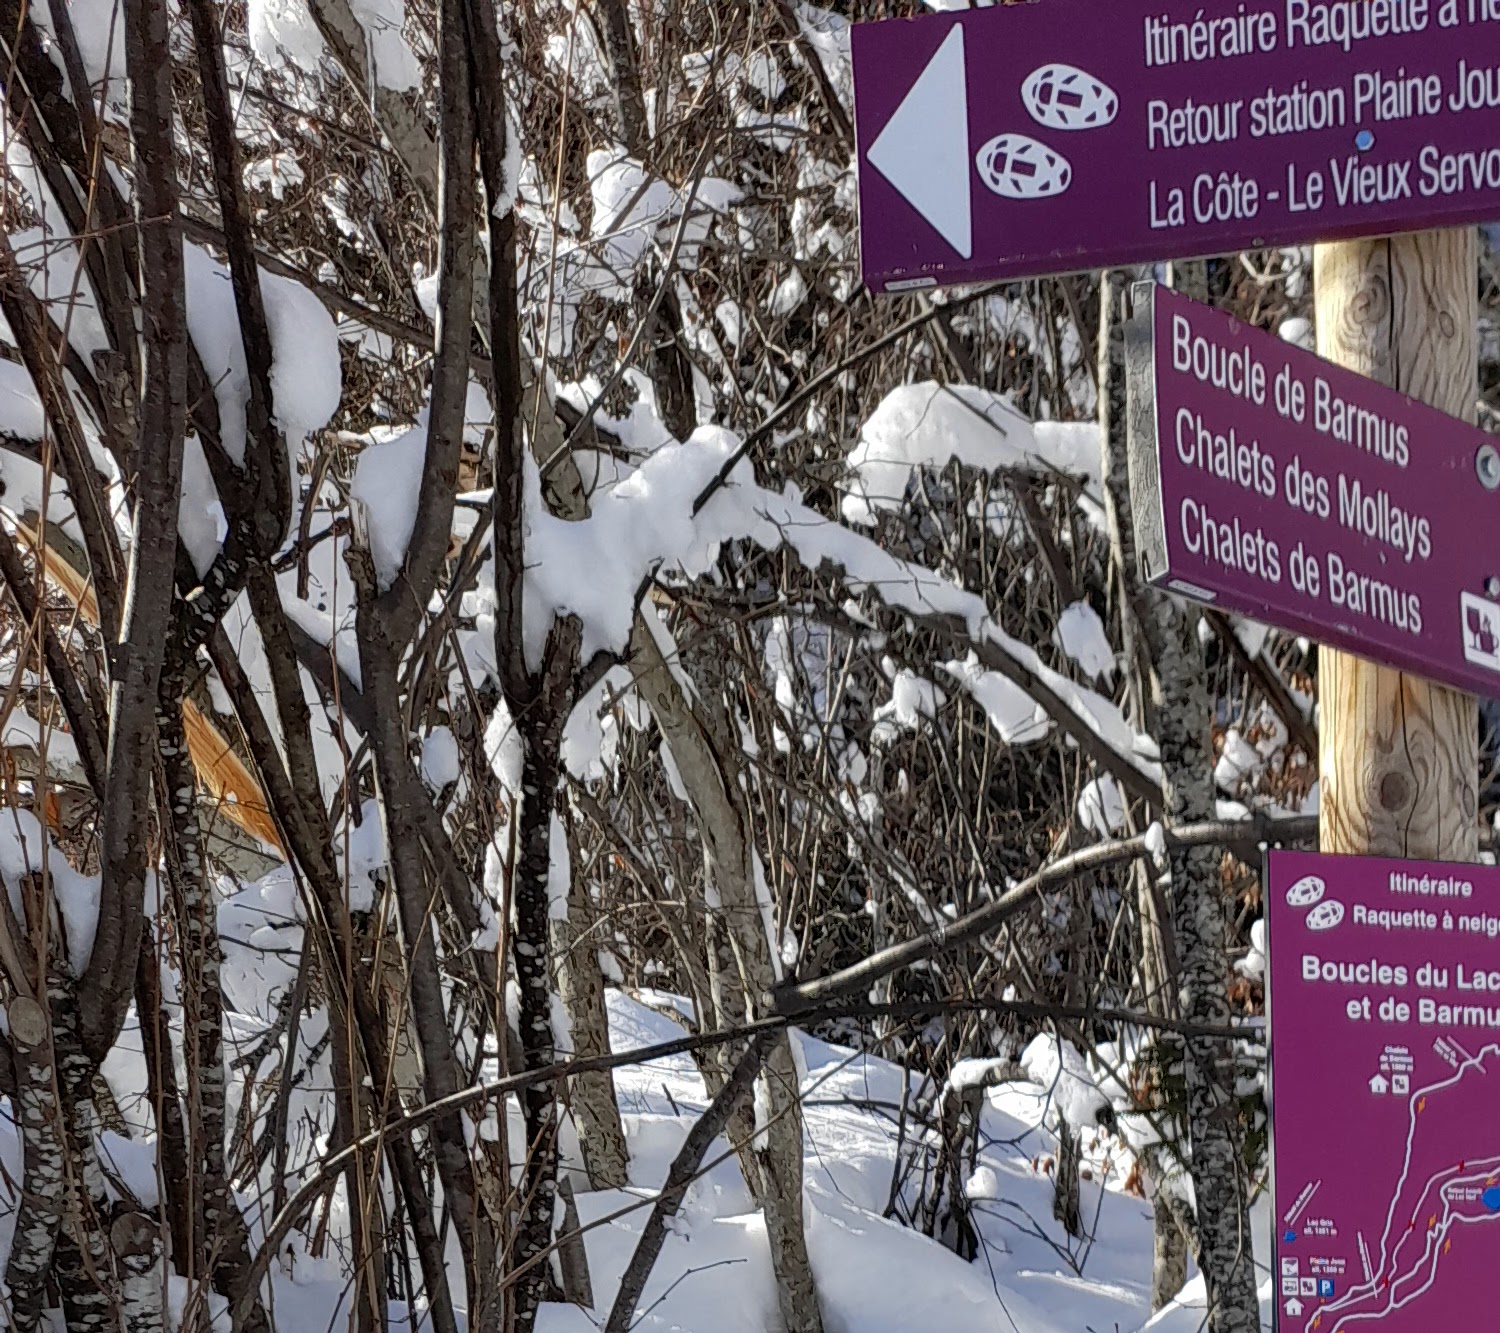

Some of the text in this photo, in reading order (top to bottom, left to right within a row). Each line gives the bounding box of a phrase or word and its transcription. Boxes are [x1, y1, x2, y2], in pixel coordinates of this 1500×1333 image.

[1145, 5, 1276, 65] Itinéraire
[1149, 99, 1242, 149] Retour
[1251, 81, 1344, 136] station
[1354, 69, 1441, 123] Plaine
[1151, 181, 1184, 228] La
[1194, 172, 1258, 223] Côte
[1289, 164, 1323, 211] Le
[1331, 156, 1411, 205] Vieux
[1174, 315, 1408, 466] Boucle de Barmus
[1177, 408, 1430, 562] Chalets des Mollays
[1182, 498, 1421, 633] Chalets de Barmus
[1354, 905, 1437, 930] Raquette
[1443, 911, 1453, 929] à
[1390, 873, 1472, 897] Itinéraire
[1303, 956, 1407, 985] Boucles
[1416, 963, 1447, 987] du
[1458, 965, 1500, 991] Lac
[1347, 997, 1371, 1019] et
[1379, 997, 1410, 1021] de
